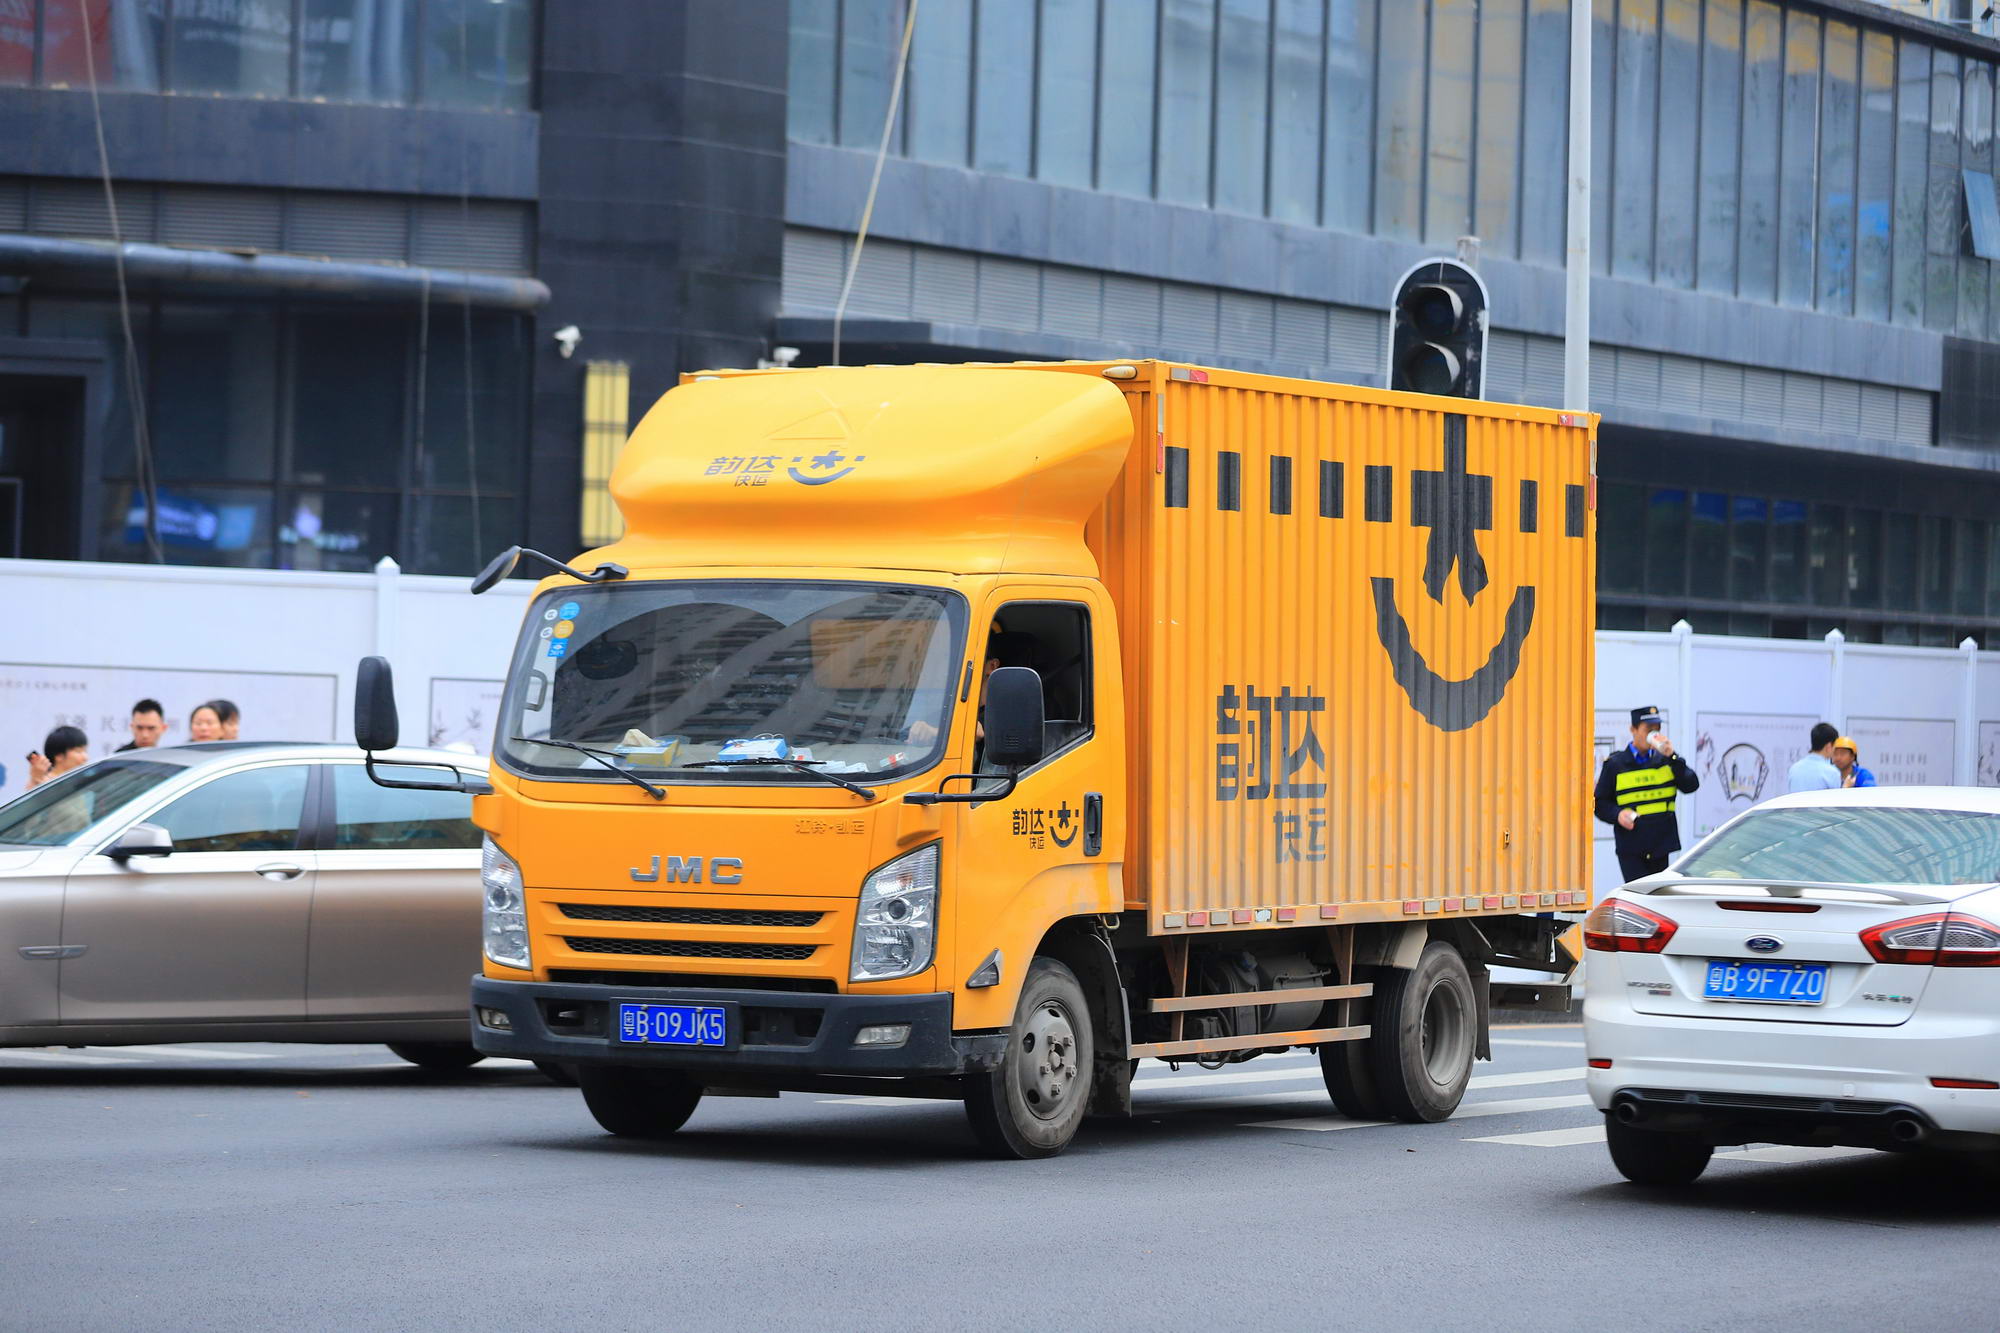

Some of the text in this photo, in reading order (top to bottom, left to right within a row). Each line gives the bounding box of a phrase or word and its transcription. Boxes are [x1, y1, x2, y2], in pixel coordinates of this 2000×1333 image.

[704, 456, 783, 476] 韵达
[1216, 684, 1327, 801] 韵达
[1012, 808, 1044, 835] 韵达
[1273, 808, 1326, 864] 快运
[629, 855, 743, 885] JMC
